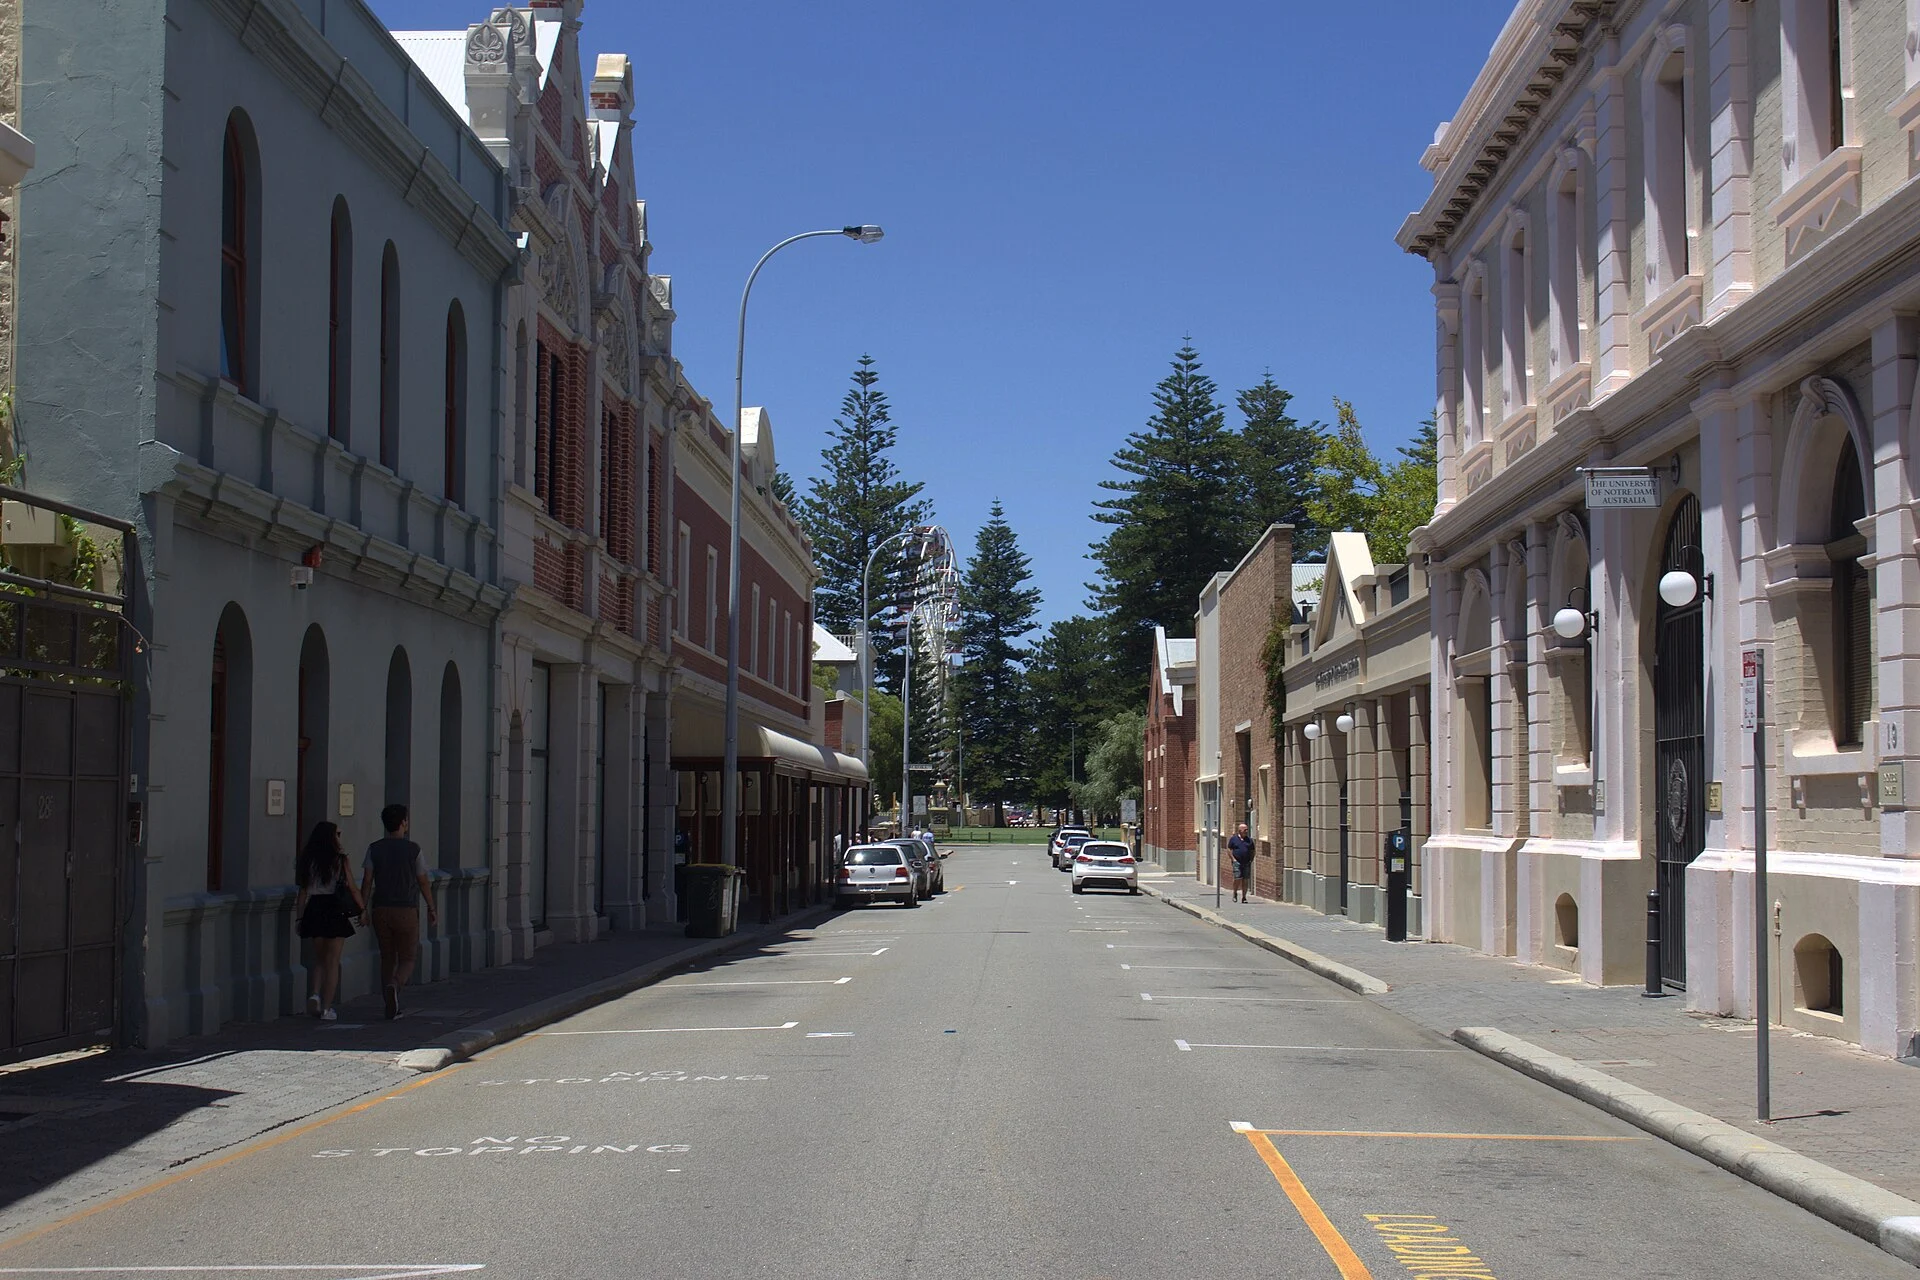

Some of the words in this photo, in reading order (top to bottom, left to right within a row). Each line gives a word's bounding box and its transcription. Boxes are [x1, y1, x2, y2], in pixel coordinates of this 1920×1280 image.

[1604, 488, 1632, 496] NOTRE
[1634, 488, 1657, 496] DAME
[1602, 496, 1647, 504] AUSTRALIA
[1887, 722, 1898, 750] 19
[1395, 836, 1404, 848] P
[477, 1075, 771, 1086] STOPPING
[471, 1135, 571, 1144] NO
[311, 1144, 692, 1157] STOPPING
